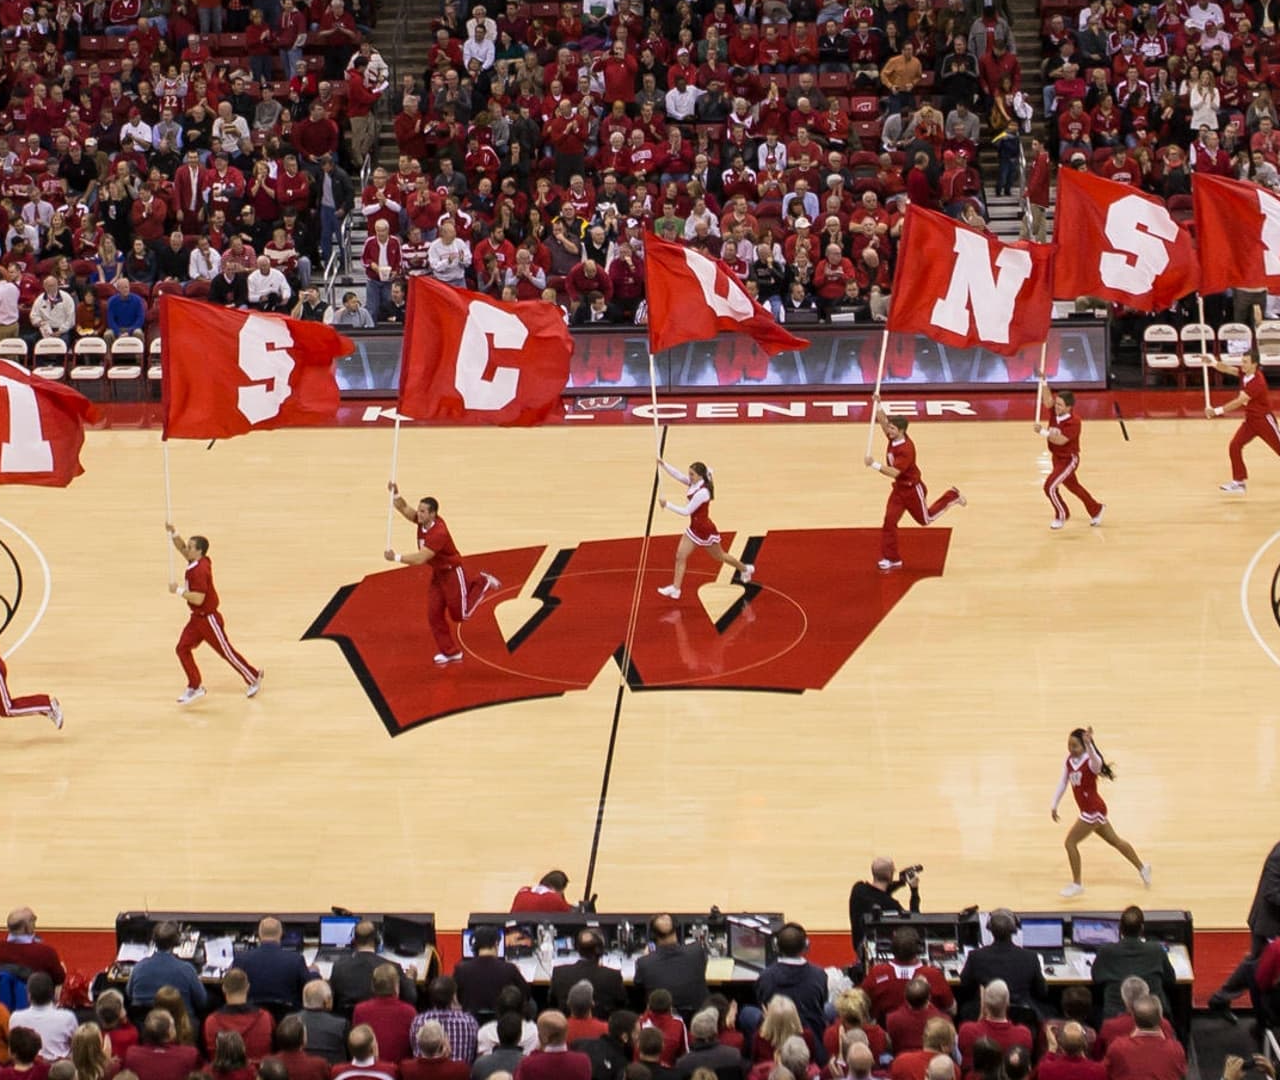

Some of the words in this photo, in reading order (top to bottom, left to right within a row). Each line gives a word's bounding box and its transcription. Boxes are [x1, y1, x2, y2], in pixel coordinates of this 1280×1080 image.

[930, 227, 1033, 344] N
[1099, 195, 1180, 295] S
[237, 315, 296, 424] S
[362, 405, 595, 421] KL
[632, 400, 977, 419] CENTER
[455, 300, 529, 411] C
[300, 526, 953, 738] W
